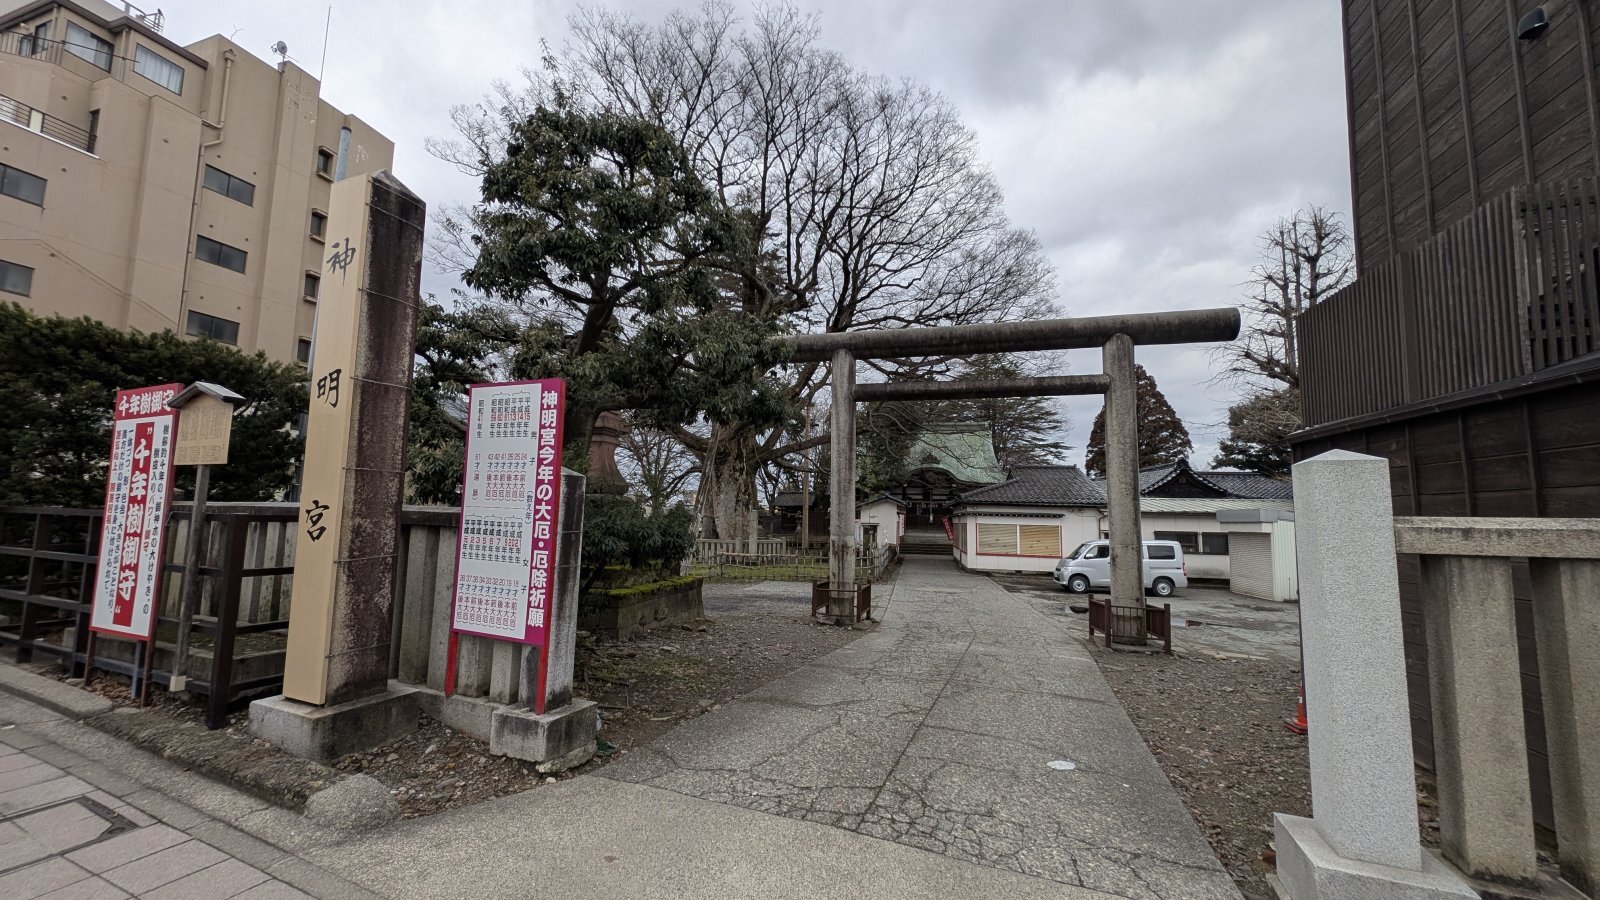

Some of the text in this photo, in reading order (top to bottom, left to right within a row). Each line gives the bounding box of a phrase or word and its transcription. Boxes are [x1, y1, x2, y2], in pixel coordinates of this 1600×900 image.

[119, 389, 174, 417] 千年樹御守
[305, 236, 356, 542] 神明宮
[527, 391, 558, 628] 神明宮今年の大厄・厄除祈願
